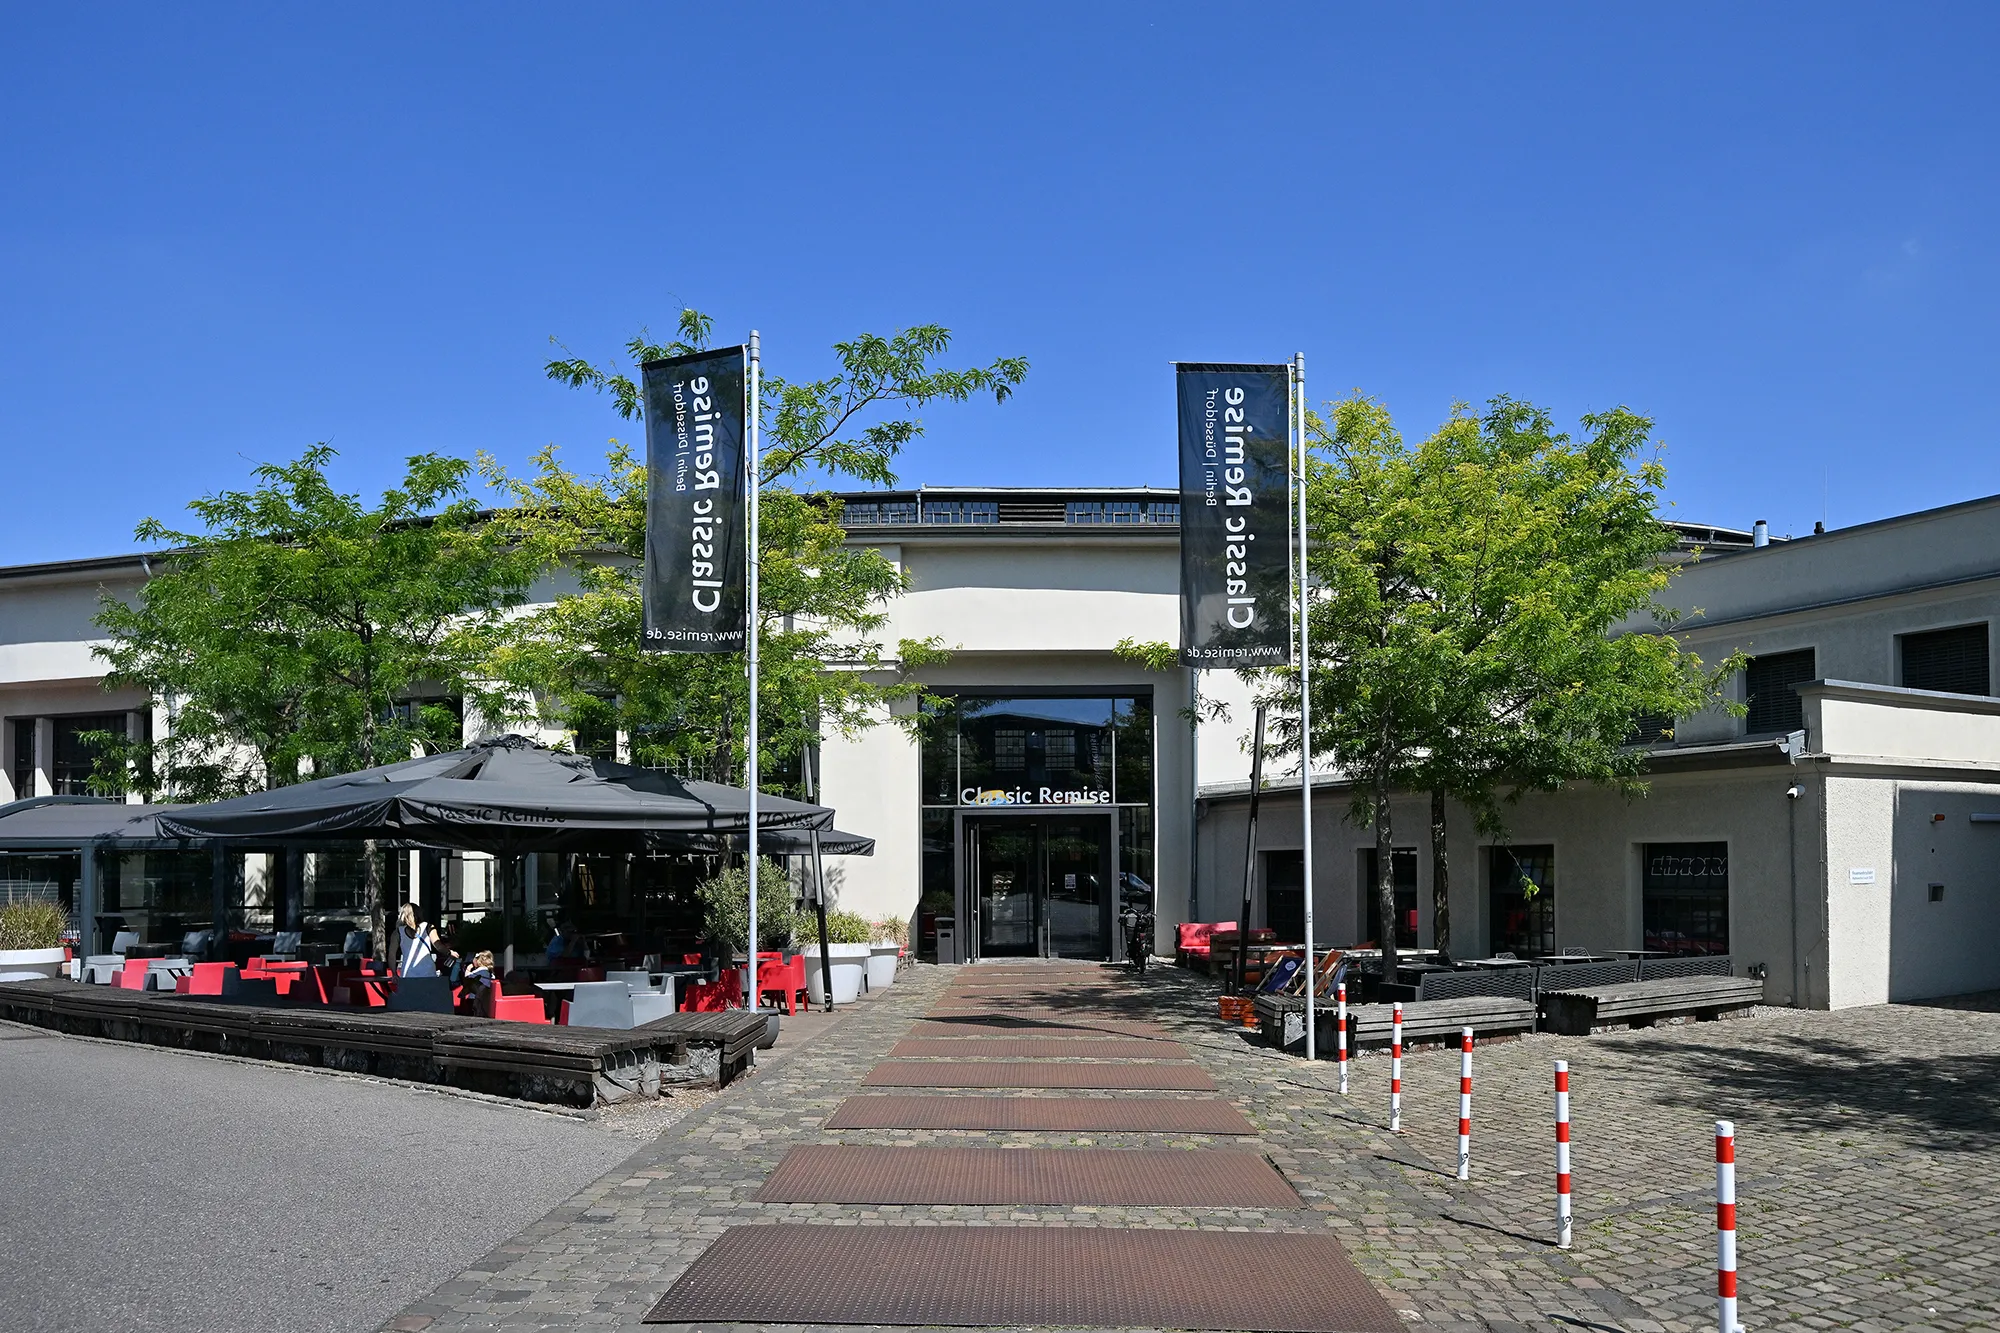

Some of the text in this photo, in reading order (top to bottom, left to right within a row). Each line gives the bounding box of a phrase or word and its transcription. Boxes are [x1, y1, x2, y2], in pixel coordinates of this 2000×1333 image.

[960, 786, 1032, 804] Classic
[1039, 786, 1110, 804] Remise
[498, 807, 567, 823] Remise
